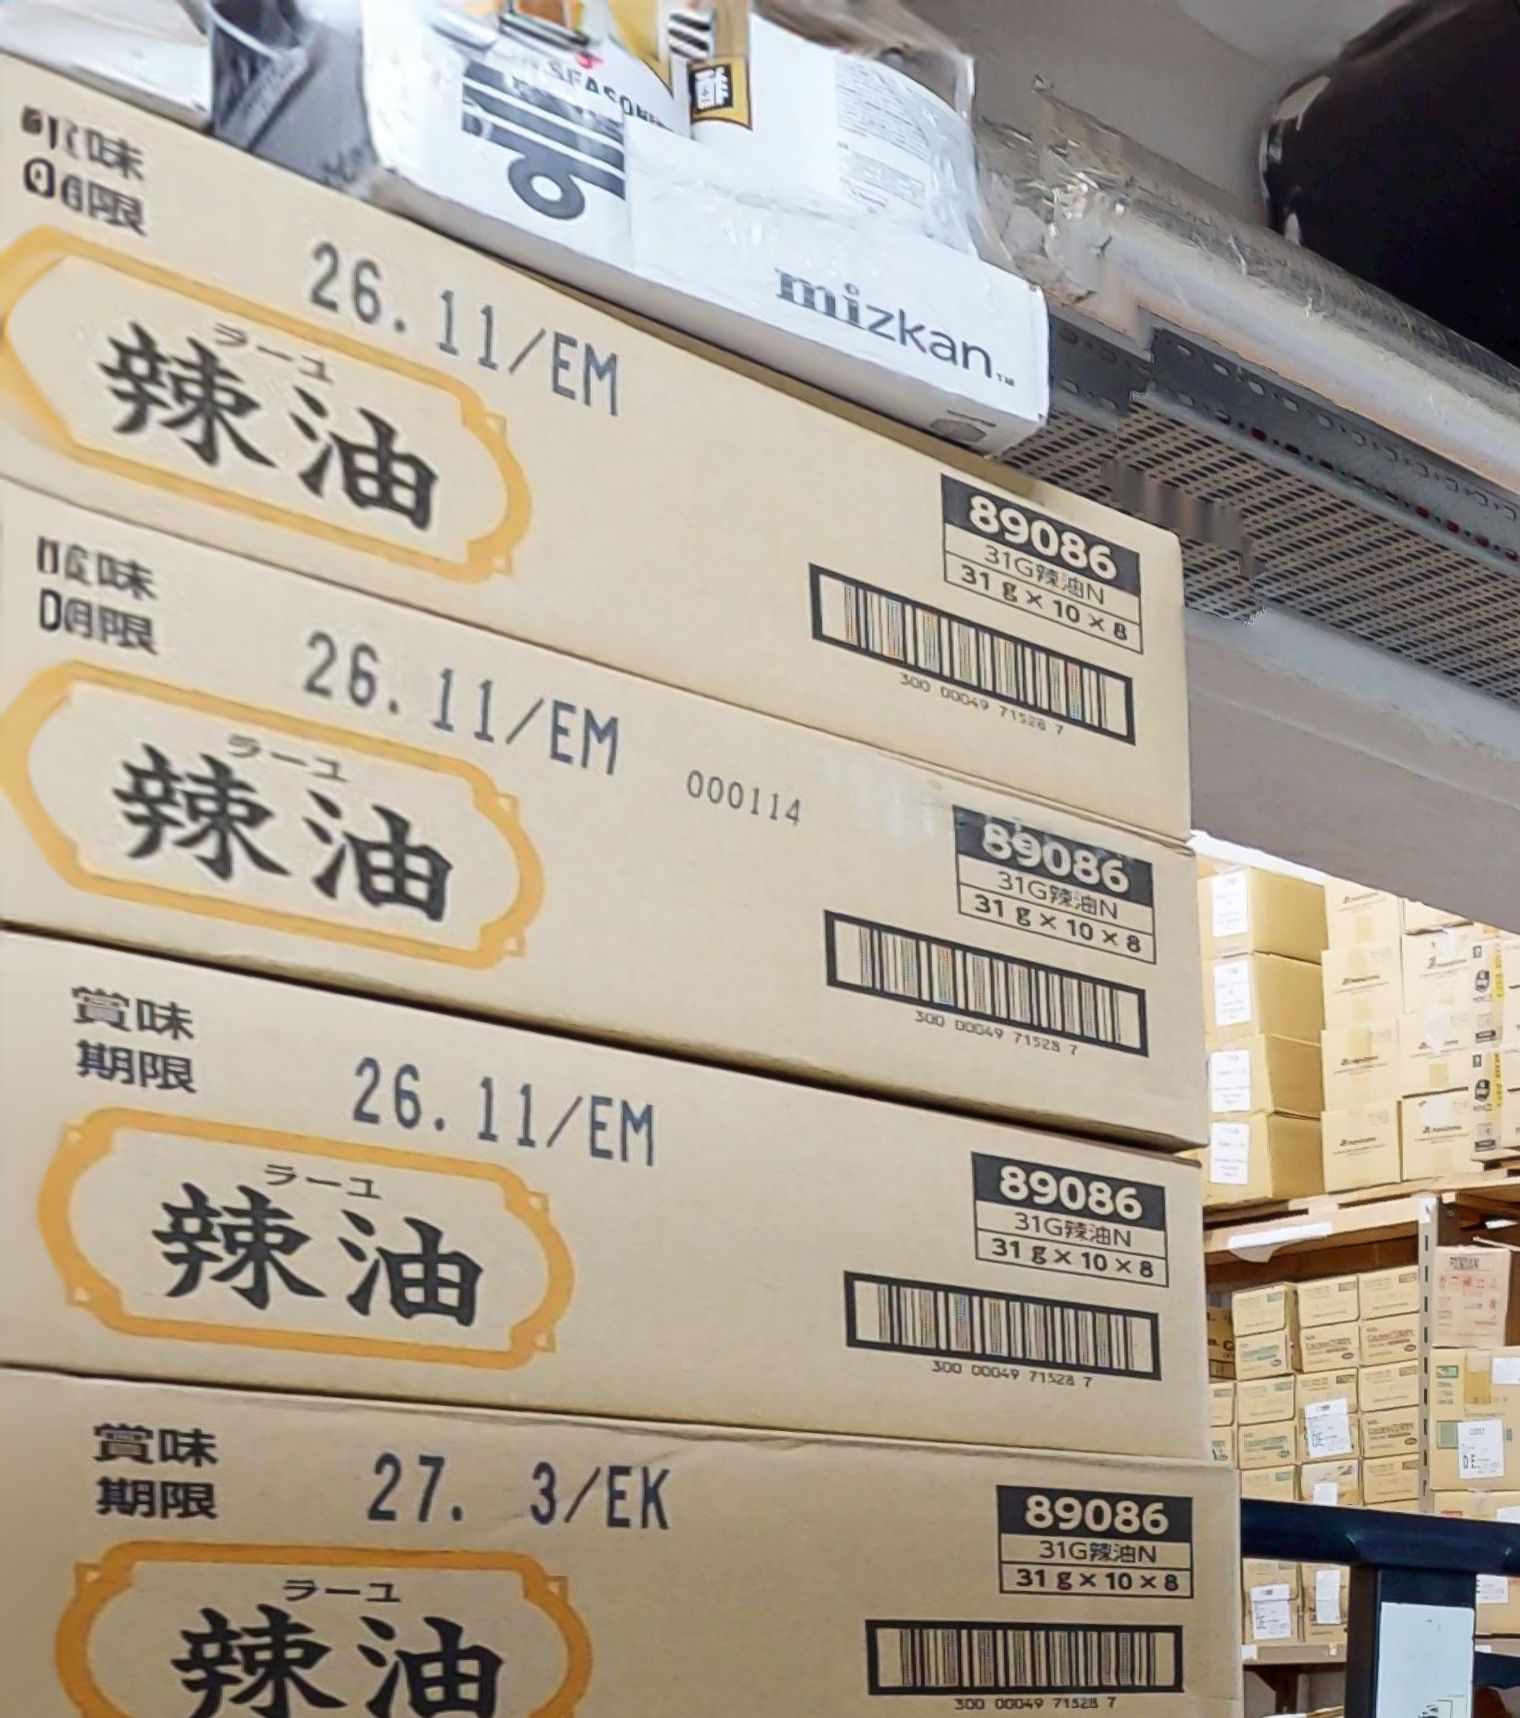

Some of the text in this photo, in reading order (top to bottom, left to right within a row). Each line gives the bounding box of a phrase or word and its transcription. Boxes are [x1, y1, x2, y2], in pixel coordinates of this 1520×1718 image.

[309, 241, 621, 417] 26.11/EM
[774, 268, 993, 379] mizkan
[96, 322, 439, 532] 辣油
[969, 495, 1118, 581] 89086
[304, 632, 619, 776] 26.11/EM
[686, 770, 801, 826] 000114
[113, 743, 453, 922] 辣油
[982, 822, 1131, 895] 89086
[72, 986, 194, 1040] 賞味
[76, 1039, 196, 1094] 期限
[351, 1056, 655, 1166] 26.11/EM
[263, 1163, 382, 1200] ラーユ
[999, 1164, 1143, 1220] 89086
[151, 1182, 484, 1327] 辣油
[92, 1424, 219, 1466] 賞味
[96, 1478, 219, 1520] 期限
[1025, 1495, 1169, 1534] 89086
[282, 1579, 400, 1603] ラーユ
